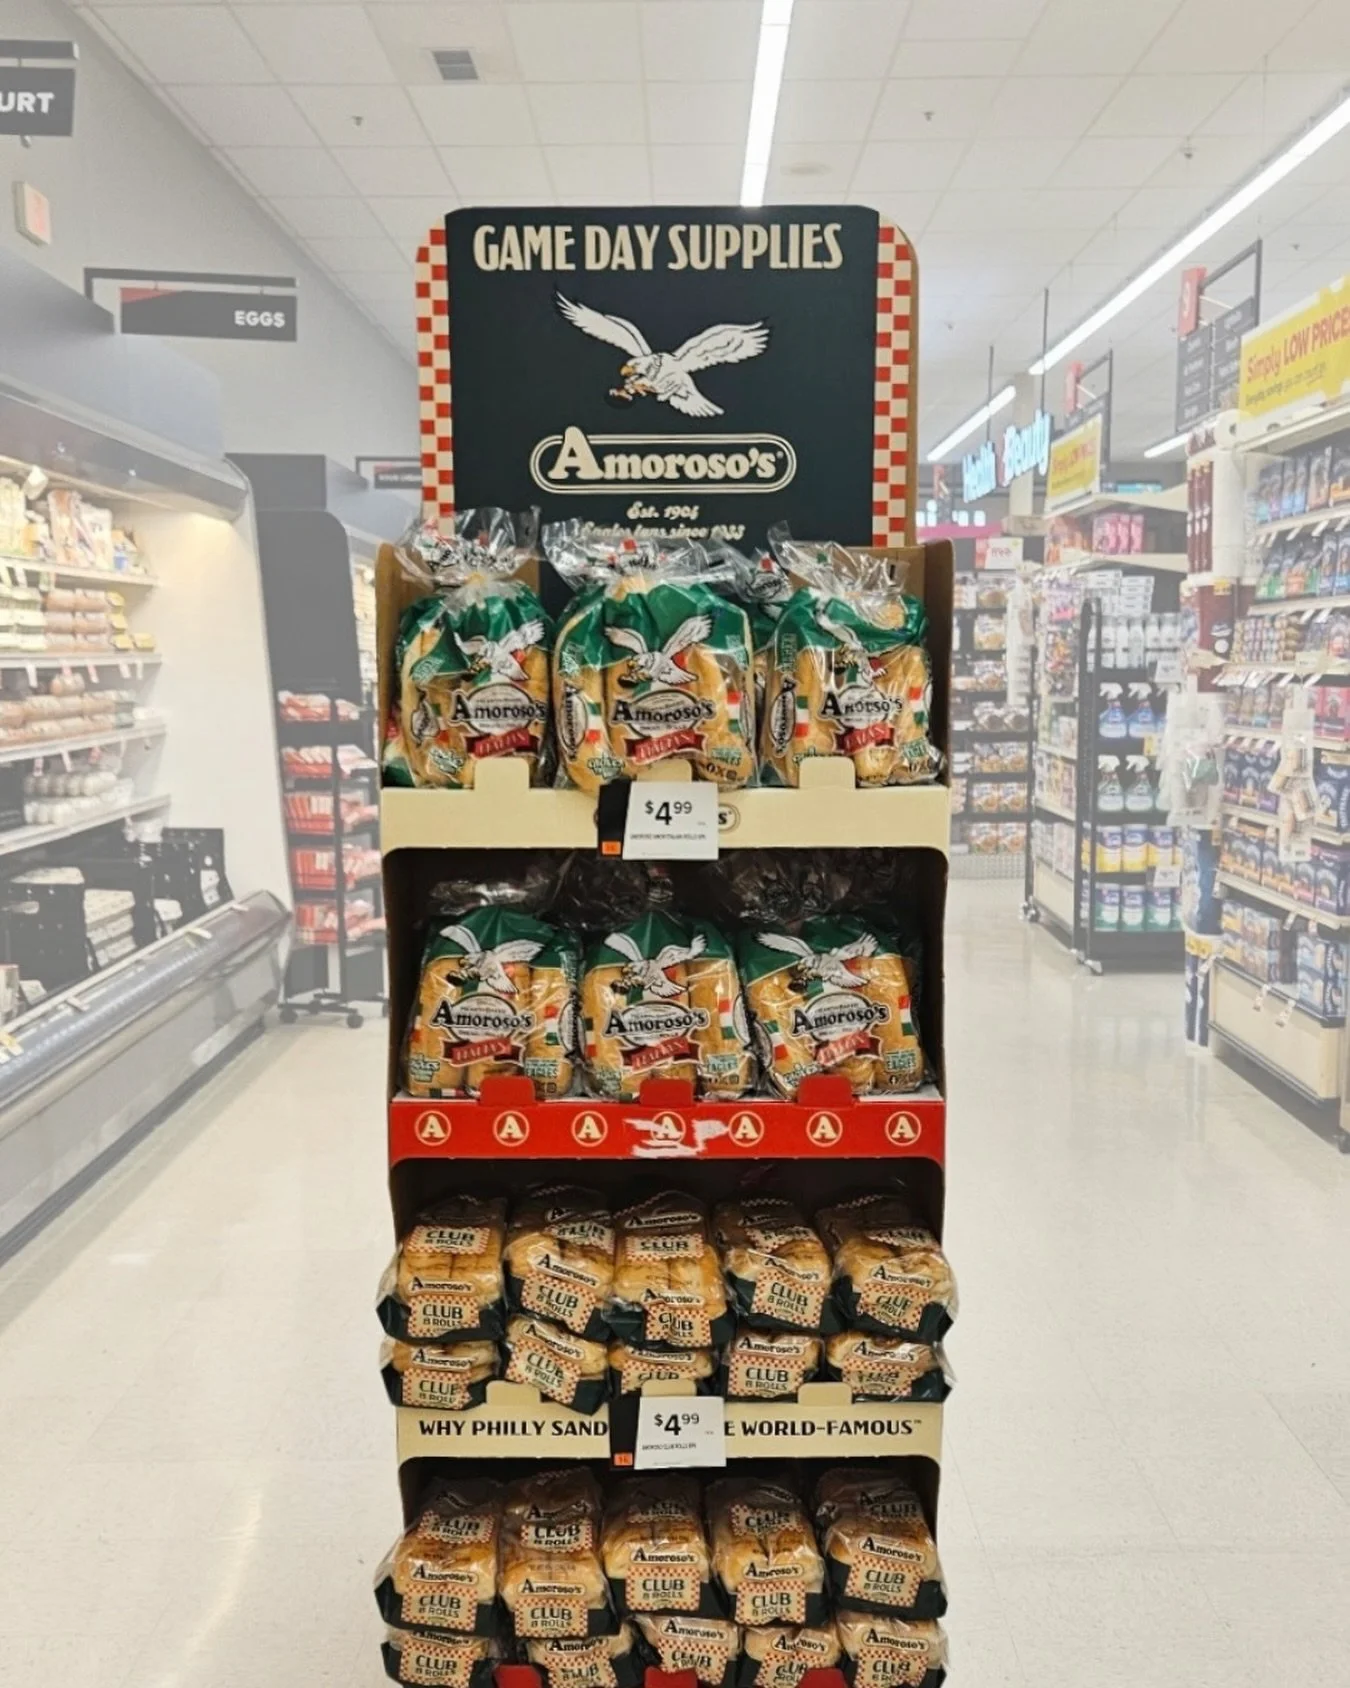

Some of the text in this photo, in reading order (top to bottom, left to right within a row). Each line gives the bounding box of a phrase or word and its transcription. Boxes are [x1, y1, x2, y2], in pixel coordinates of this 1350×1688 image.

[474, 223, 843, 271] GAME DAY SUPPLIES
[235, 310, 285, 328] EGGS
[1284, 326, 1310, 366] LOW
[1003, 408, 1050, 487] Beauty
[627, 501, 659, 519] Est.
[452, 697, 547, 721] Amoroso's
[612, 700, 714, 723] Amoroso's
[432, 1000, 532, 1028] Amoroso's
[605, 1010, 707, 1035] Amoroso's
[792, 1005, 888, 1034] Amoroso's
[426, 1230, 475, 1241] CLUB
[538, 1254, 597, 1287] Amoroso's
[411, 1277, 471, 1292] Amoroso's
[539, 1286, 579, 1309] CLUB
[770, 1282, 808, 1306] CLUB
[422, 1304, 463, 1319] CLUB
[767, 1296, 805, 1315] 8 ROLLS
[739, 1337, 800, 1354] Amoroso's
[527, 1353, 564, 1379] CLUB
[745, 1368, 789, 1382] CLUB
[755, 1382, 787, 1390] ROLLS
[419, 1420, 466, 1436] WHY
[472, 1420, 545, 1436] PHILLY
[634, 1547, 695, 1562] Amoroso's
[863, 1537, 922, 1562] Amoroso's
[413, 1565, 473, 1582] Amoroso's
[865, 1570, 906, 1585] CLUB
[522, 1579, 583, 1594] Amoroso's
[642, 1579, 684, 1592] CLUB
[872, 1584, 901, 1593] ROLLS
[419, 1595, 461, 1609] CLUB
[652, 1591, 683, 1599] ROLLS
[752, 1593, 791, 1608] CLUB
[428, 1607, 459, 1618] ROLLS
[530, 1607, 572, 1620] CLUB
[762, 1607, 791, 1616] ROLLS
[541, 1620, 572, 1628] ROLLS
[665, 1620, 724, 1639] Amoroso's
[866, 1628, 925, 1650] Amoroso's
[416, 1655, 457, 1669] CLUB
